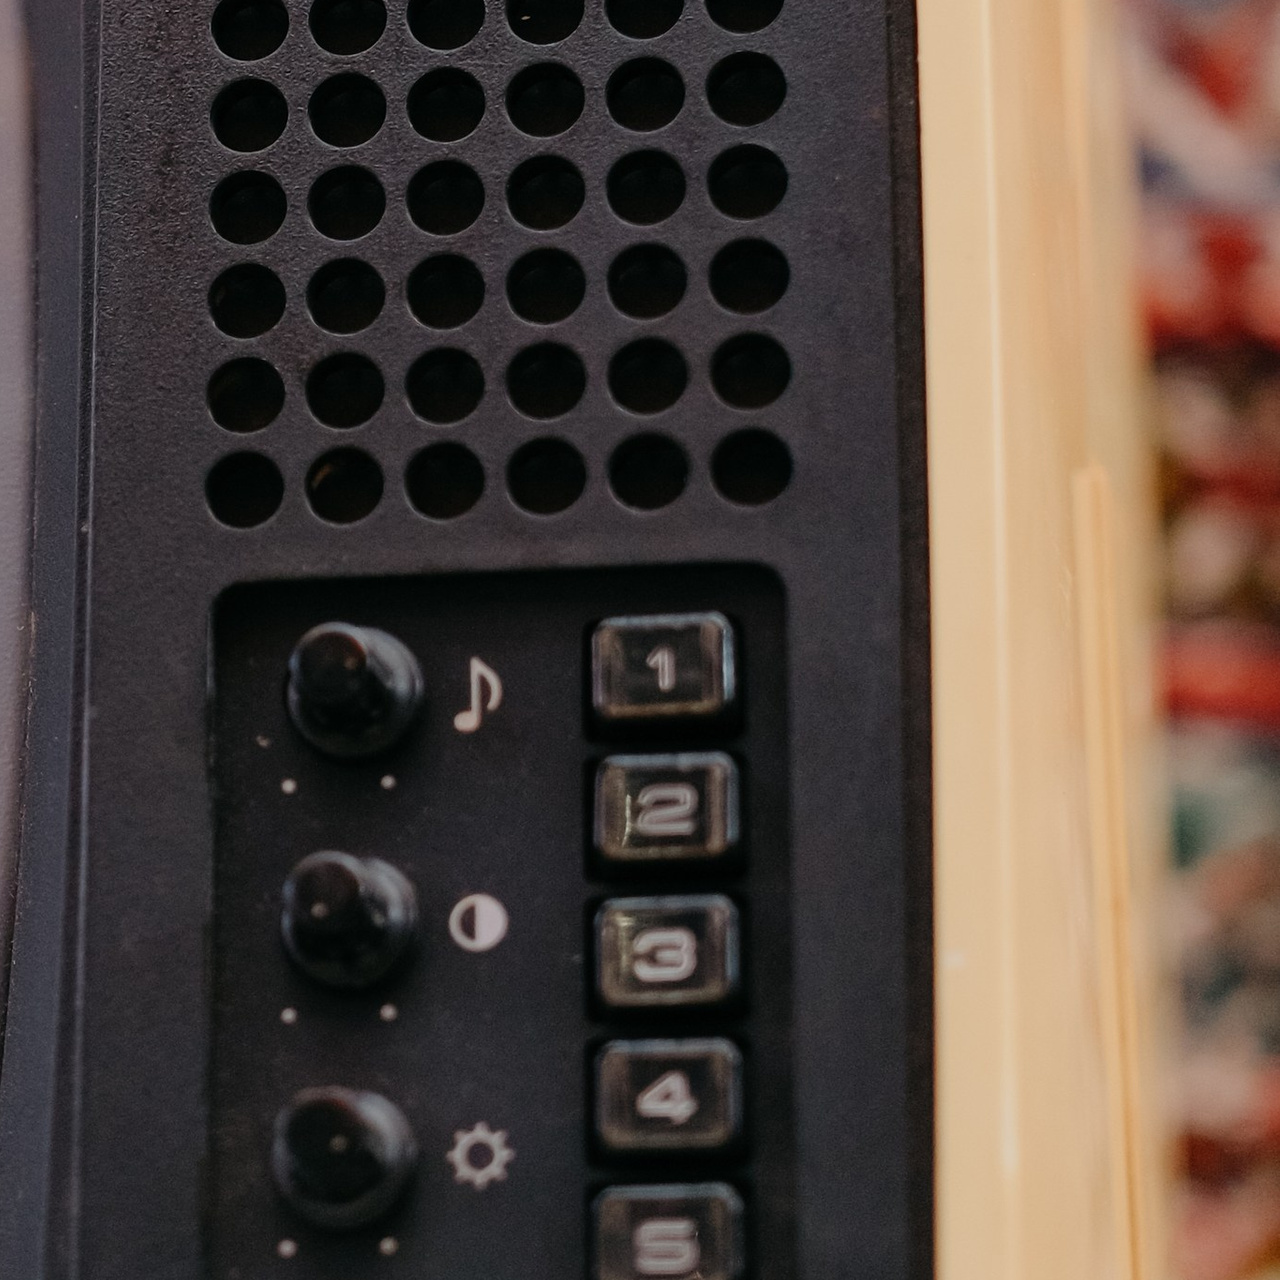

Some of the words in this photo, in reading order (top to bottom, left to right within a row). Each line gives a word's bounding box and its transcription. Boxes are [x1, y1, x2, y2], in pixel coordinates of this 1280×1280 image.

[646, 643, 677, 691] 1
[637, 781, 699, 838] 2
[632, 926, 698, 983] 3
[635, 1069, 699, 1125] 4
[632, 1216, 701, 1276] 5
